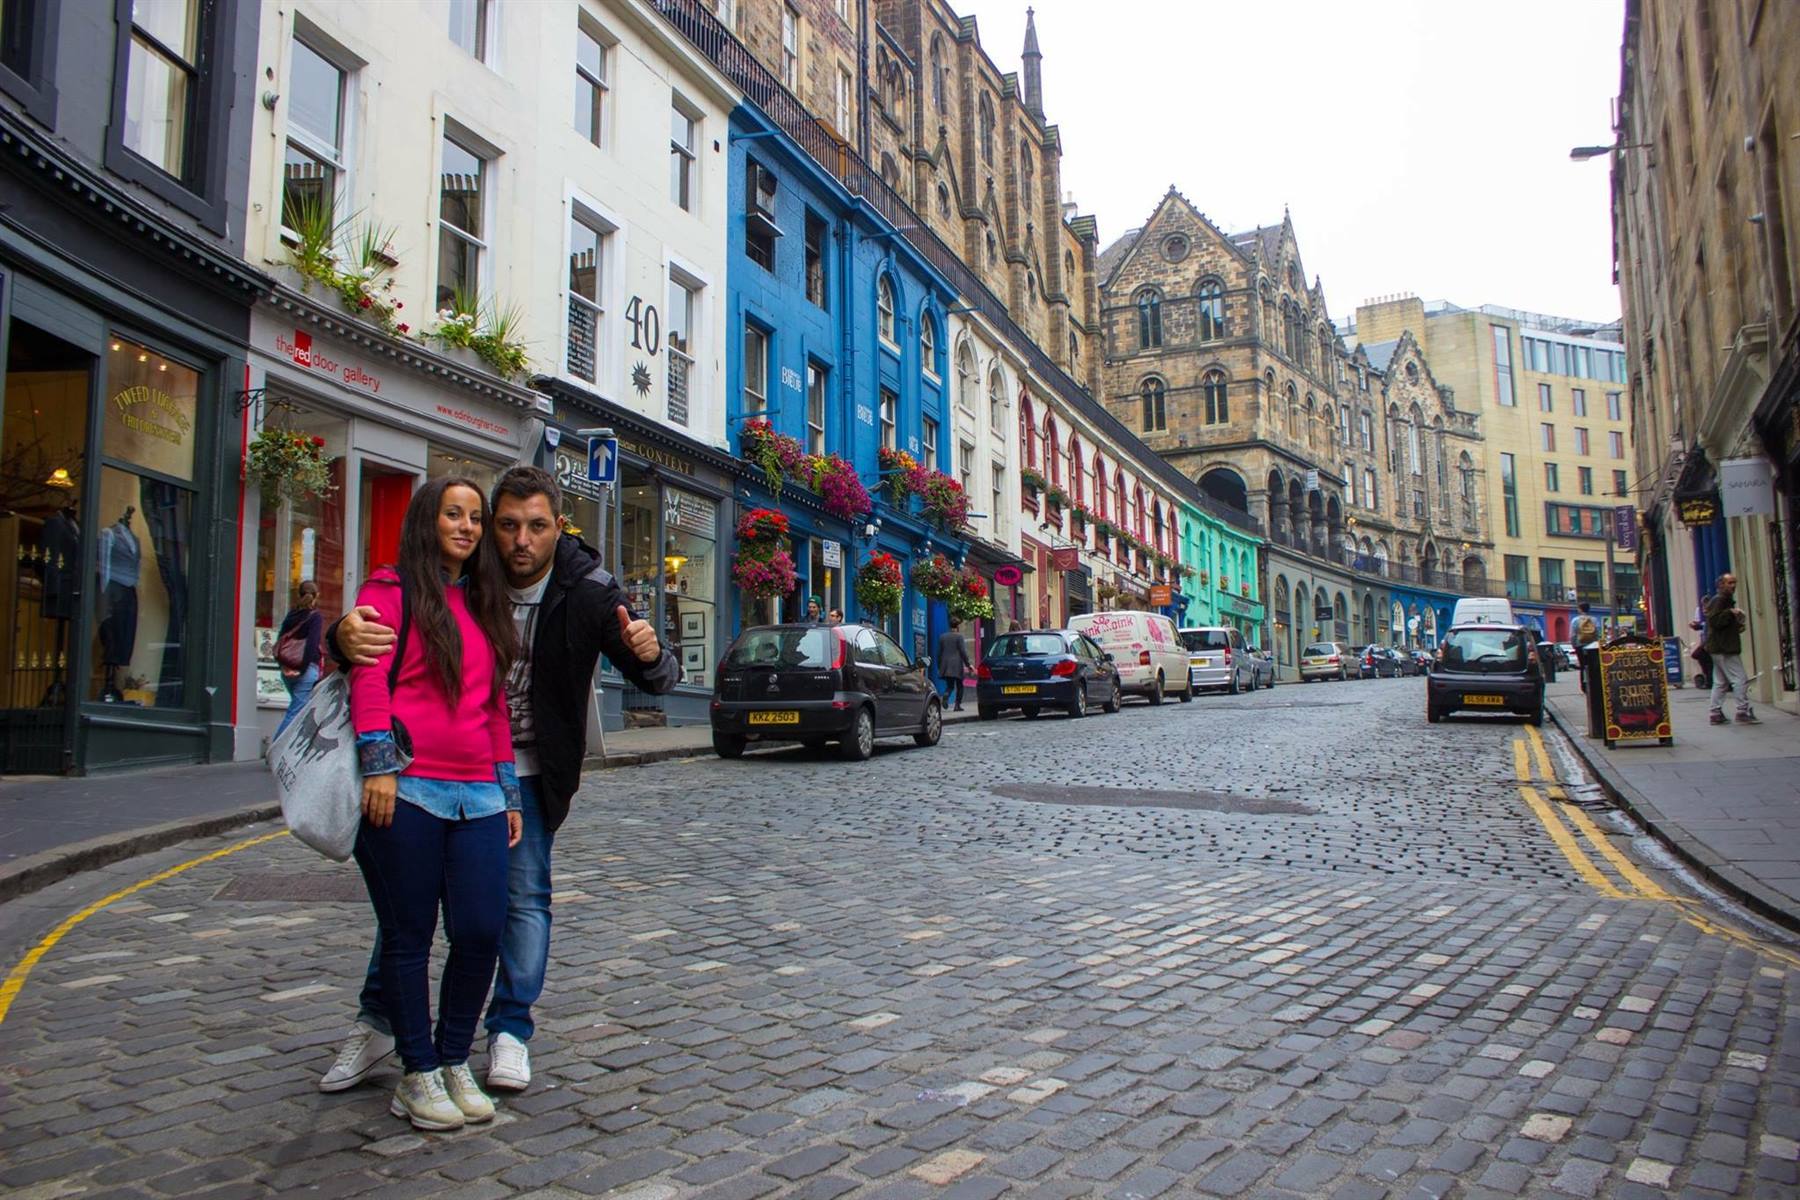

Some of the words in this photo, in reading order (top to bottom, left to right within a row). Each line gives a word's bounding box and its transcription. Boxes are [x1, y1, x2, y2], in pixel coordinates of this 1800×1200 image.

[625, 296, 660, 356] 40
[276, 336, 293, 355] the
[295, 346, 311, 362] red
[313, 354, 338, 374] door
[343, 367, 380, 393] gallery
[113, 386, 149, 410] TWEED
[556, 455, 571, 487] 2
[639, 444, 691, 474] CONTEXT
[1617, 656, 1648, 667] TOURS
[1610, 669, 1657, 681] TONIGHT
[1620, 694, 1655, 706] WITHIN
[772, 712, 795, 721] 2503
